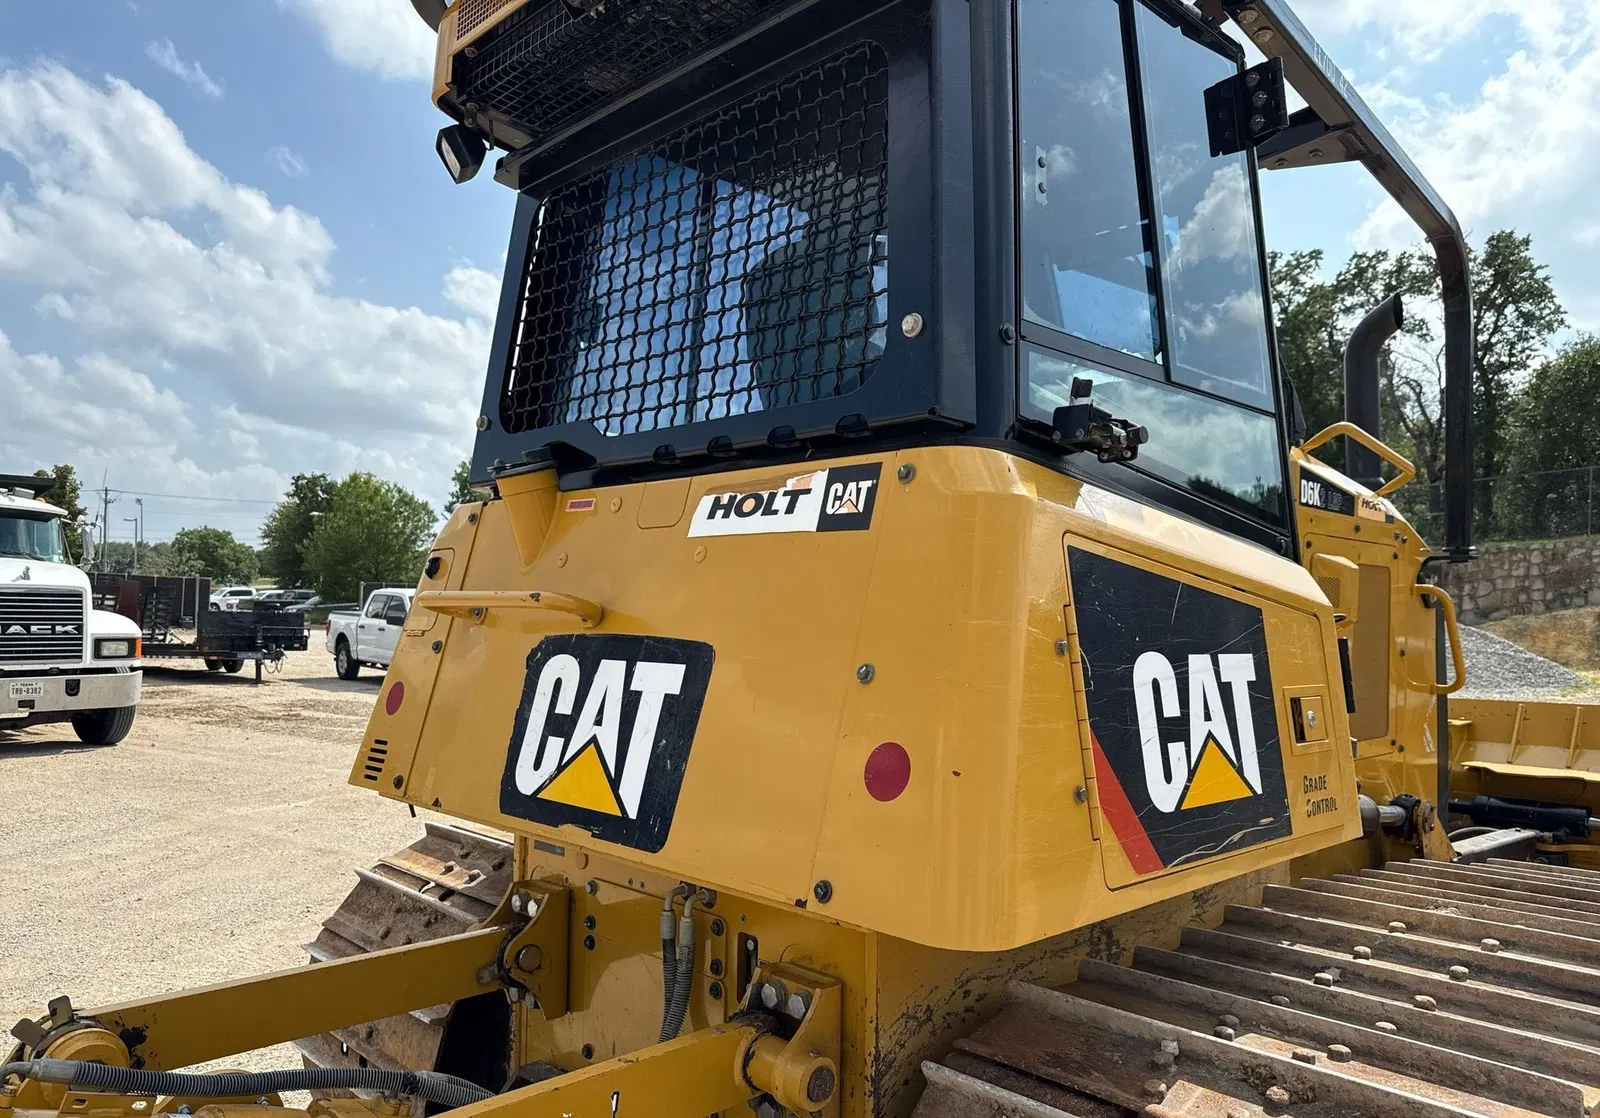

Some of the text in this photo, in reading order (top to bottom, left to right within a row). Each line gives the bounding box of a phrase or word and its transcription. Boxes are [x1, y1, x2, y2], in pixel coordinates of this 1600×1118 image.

[706, 479, 873, 520] HOLT CAT
[0, 625, 79, 634] ACK
[515, 654, 687, 820] CAT
[1133, 651, 1263, 813] CAT
[1303, 775, 1327, 794] GRADE
[1306, 797, 1338, 818] CONTROL
